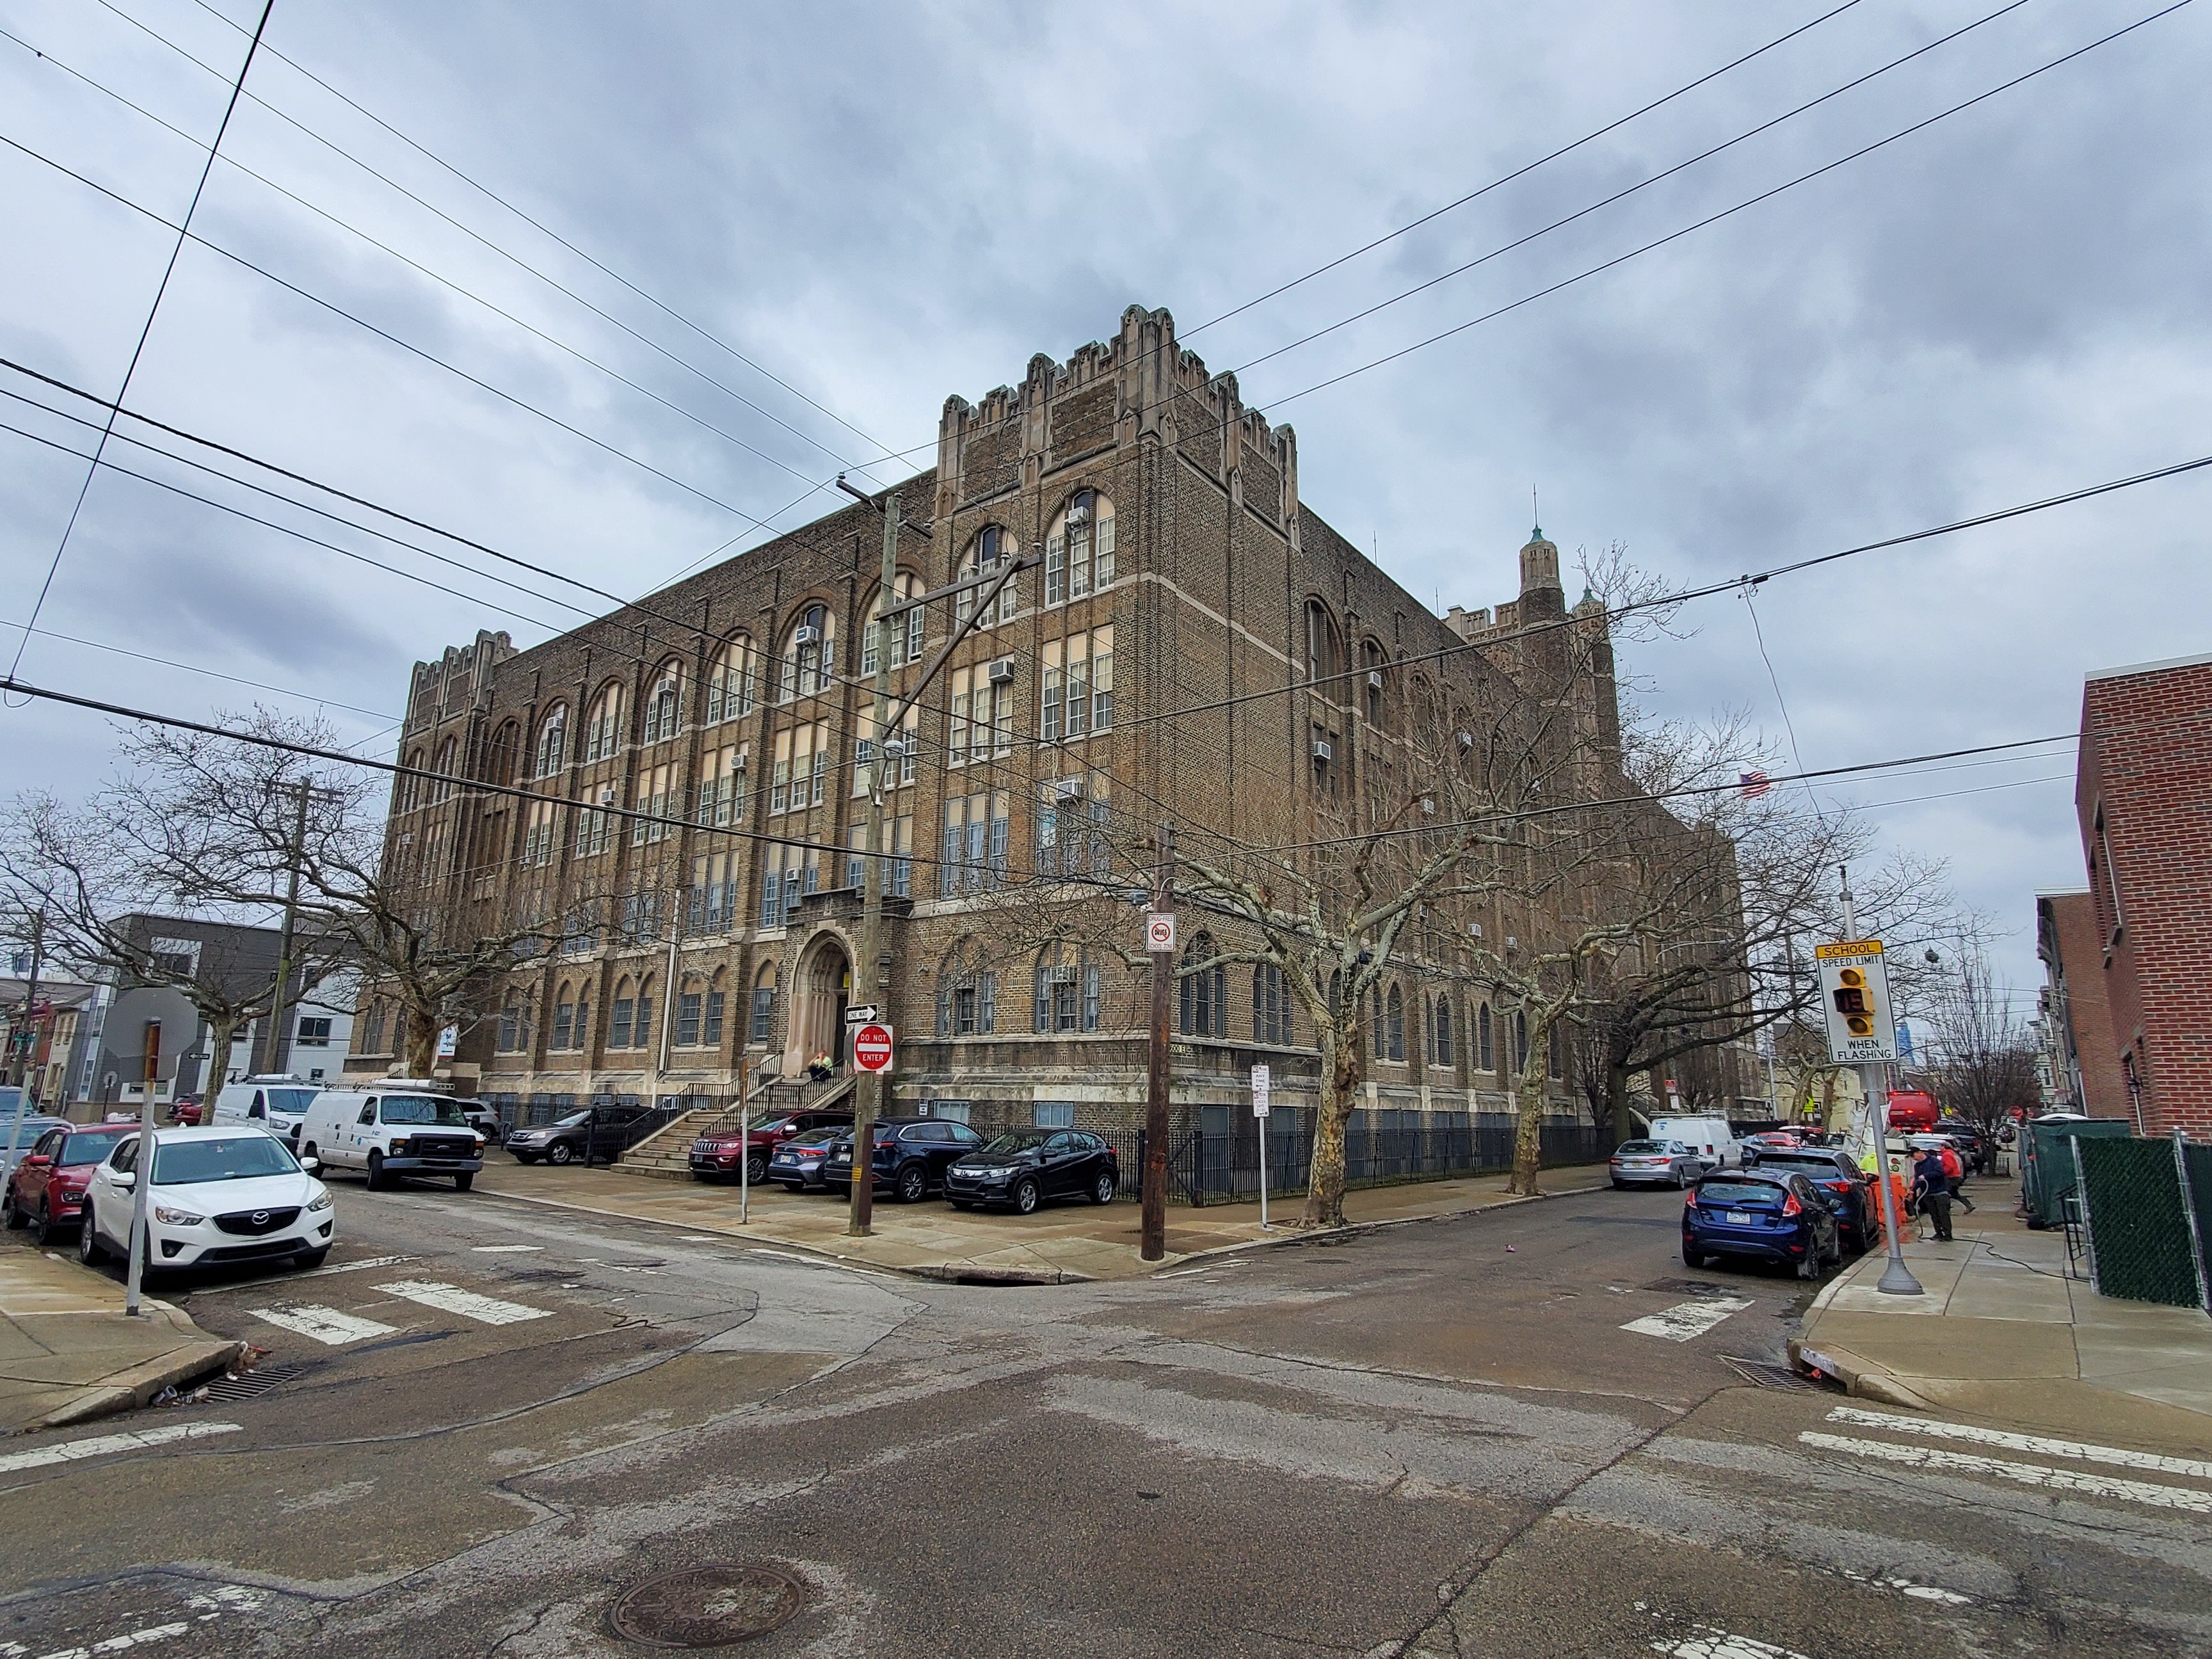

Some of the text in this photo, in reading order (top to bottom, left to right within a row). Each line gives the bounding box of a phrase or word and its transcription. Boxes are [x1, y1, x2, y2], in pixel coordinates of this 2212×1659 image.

[1824, 944, 1875, 956] SCHOOL
[1822, 955, 1879, 968] SPEED LIMIT
[1844, 994, 1862, 1010] 15
[1847, 1039, 1879, 1049] WHEN
[1838, 1049, 1891, 1060] FLASHING
